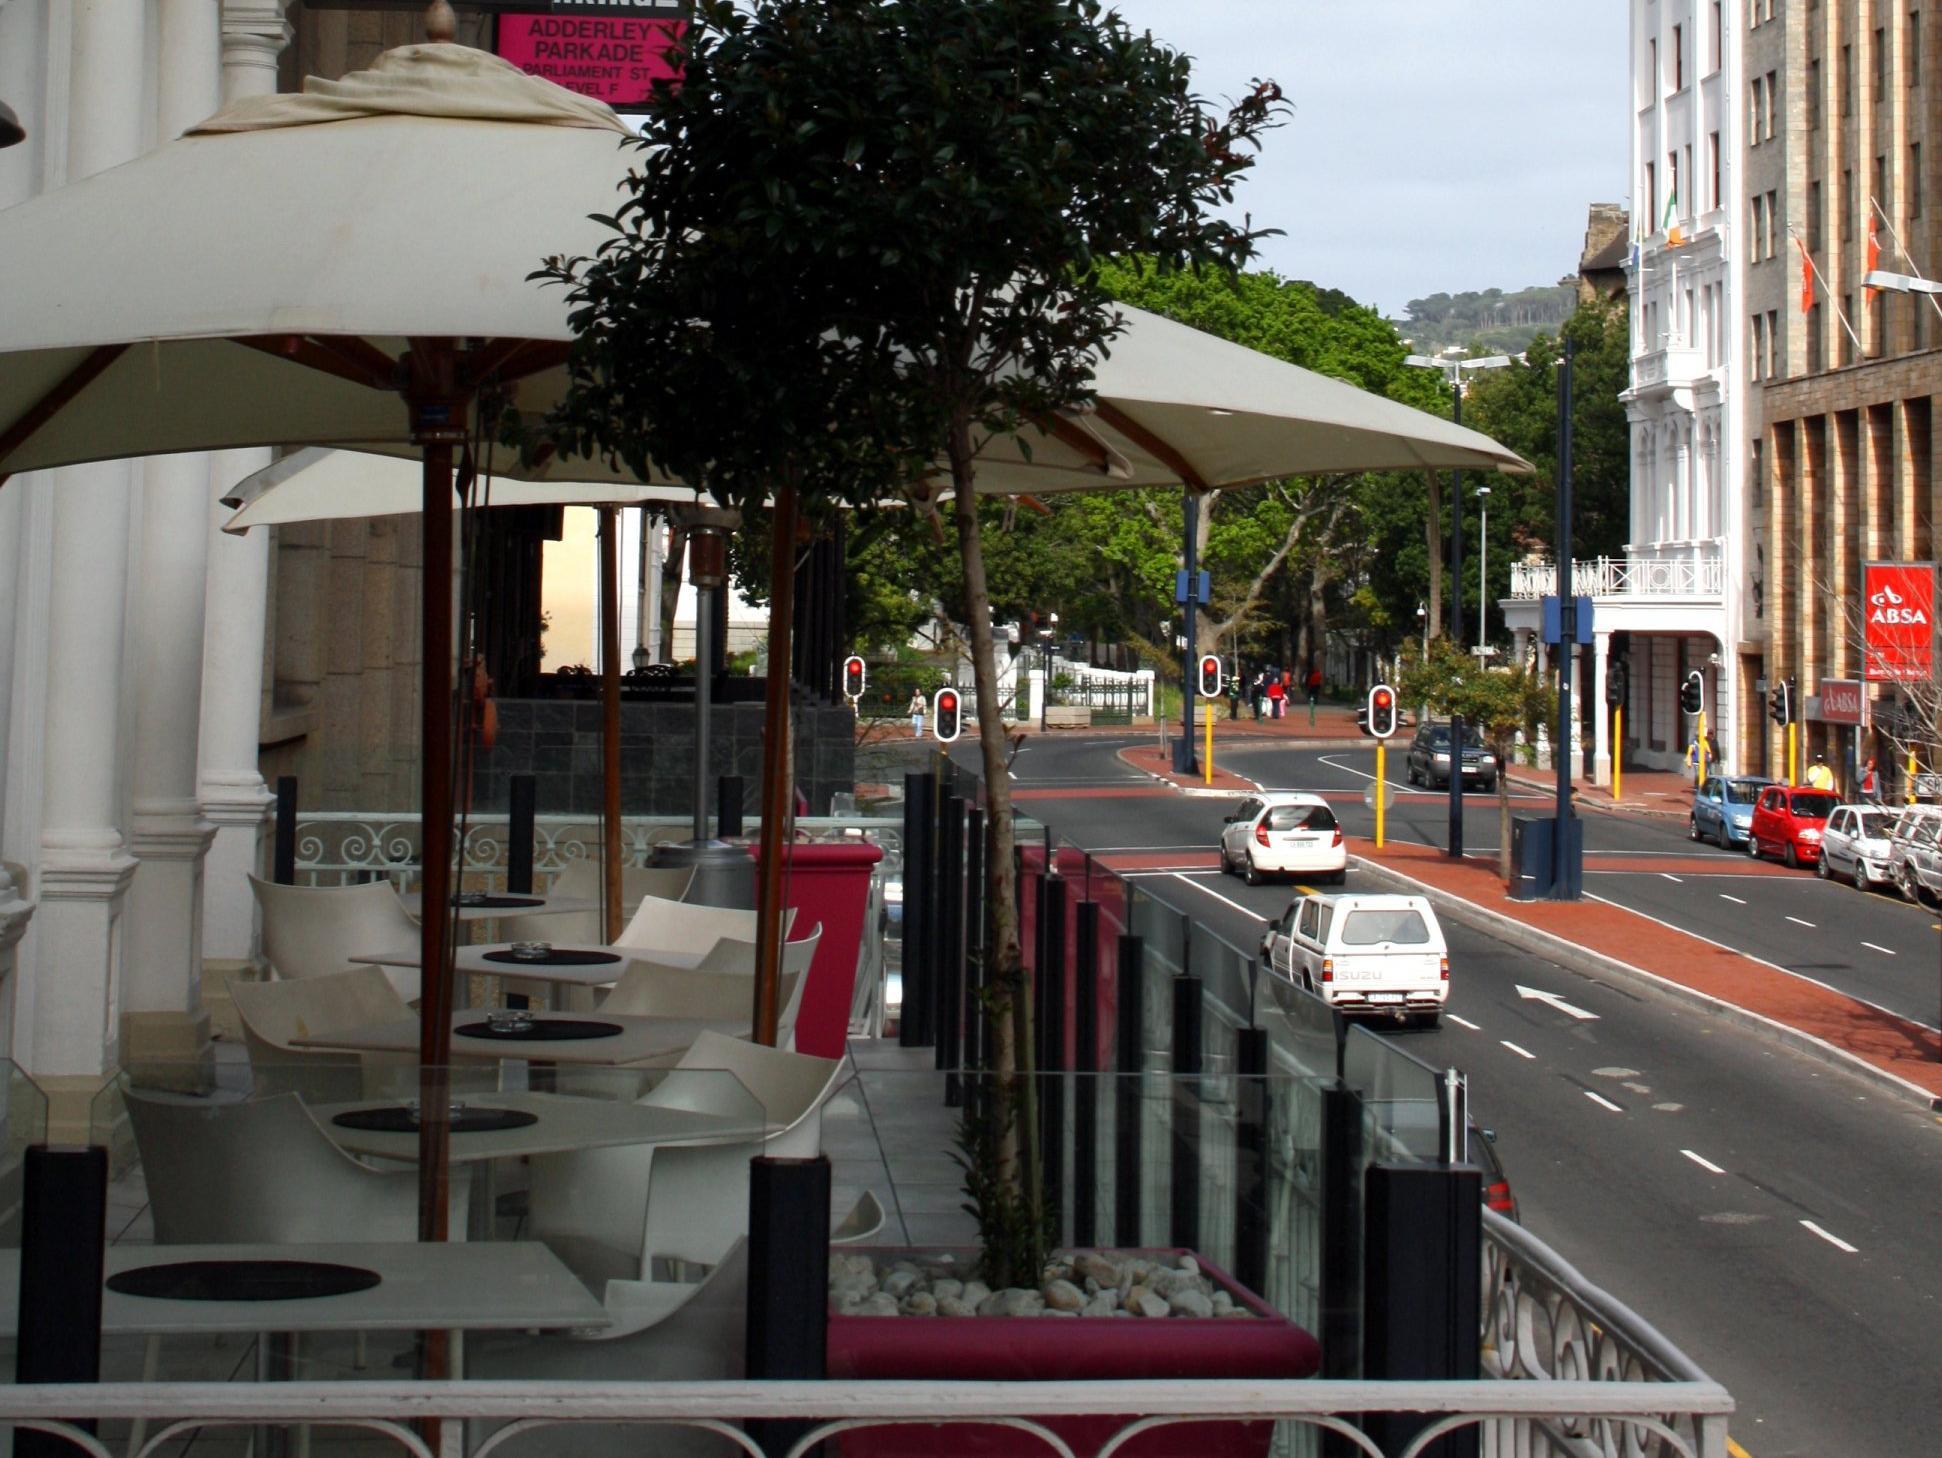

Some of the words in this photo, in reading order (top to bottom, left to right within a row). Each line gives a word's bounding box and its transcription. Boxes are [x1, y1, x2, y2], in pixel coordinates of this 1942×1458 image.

[529, 19, 651, 40] ADDERLEY
[535, 41, 643, 62] PARKADE
[523, 63, 623, 79] PARLIAMENT
[630, 67, 650, 80] ST
[560, 82, 603, 95] EVEL
[1871, 608, 1927, 624] ABSA
[1335, 970, 1382, 980] ISUZU
